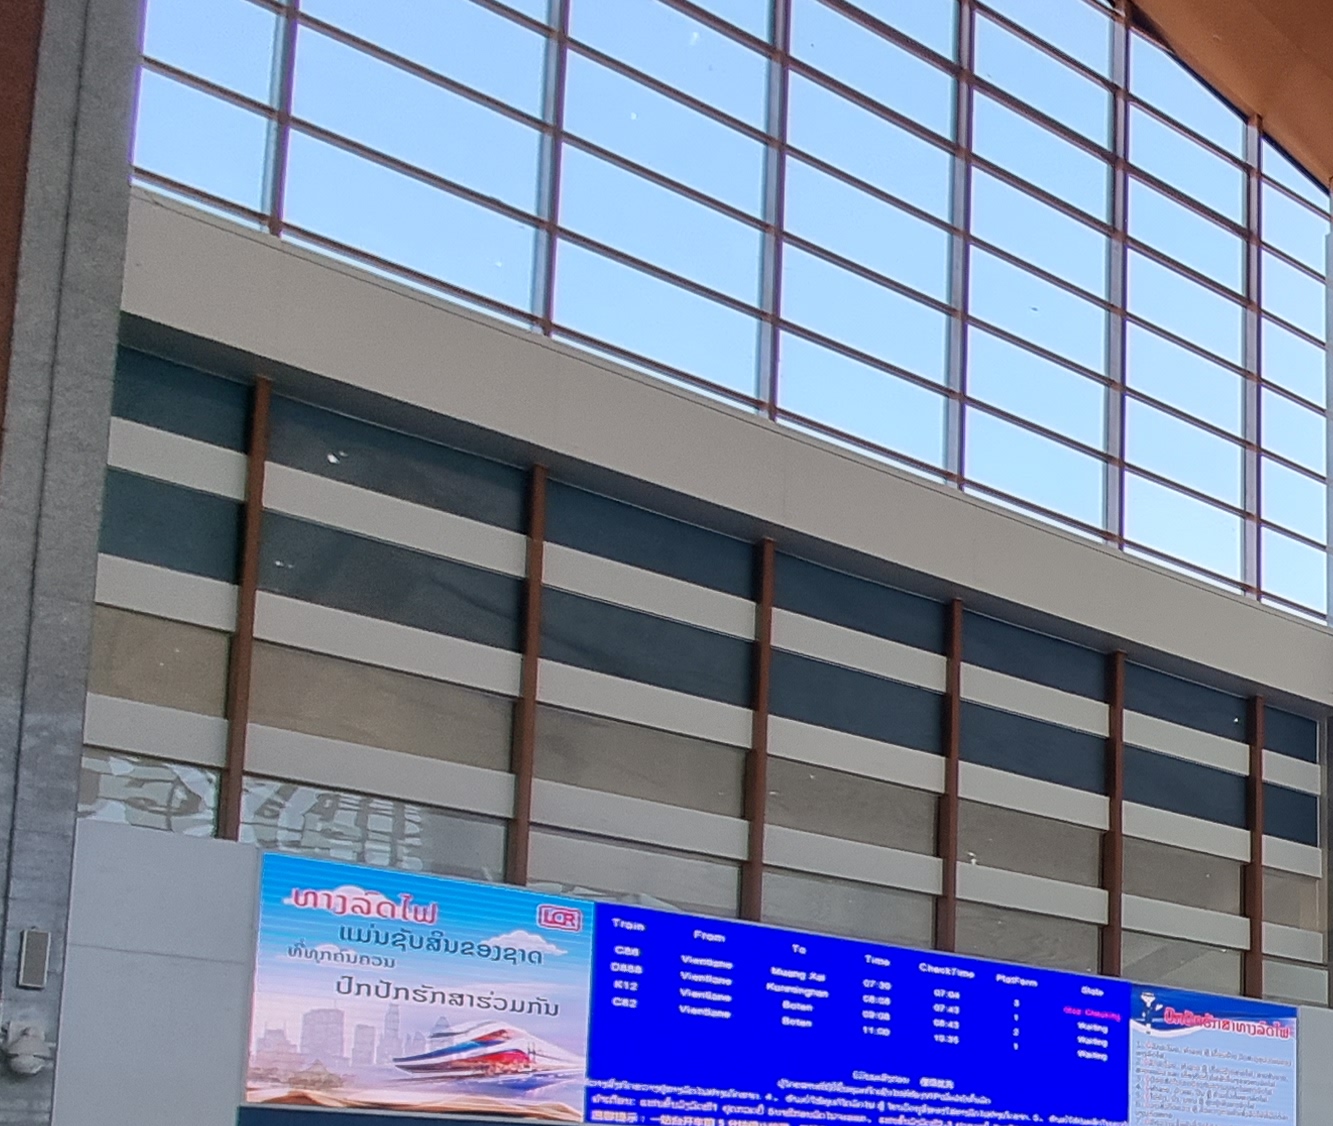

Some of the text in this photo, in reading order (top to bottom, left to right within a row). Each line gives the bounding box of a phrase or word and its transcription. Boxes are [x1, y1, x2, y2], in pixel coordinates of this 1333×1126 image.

[292, 886, 440, 925] ທາງລົດໄຟ
[611, 917, 646, 931] Train
[693, 929, 726, 943] From
[792, 943, 807, 955] To
[864, 954, 891, 967] Time
[996, 973, 1038, 988] Platform
[680, 954, 734, 970] Vientiane
[613, 980, 638, 992] K12
[679, 988, 733, 1003] Vientiane
[782, 999, 814, 1012] Boten
[1077, 1035, 1109, 1049] Waiting
[678, 1004, 732, 1019] Vientiane
[781, 1015, 813, 1028] Boten
[1077, 1049, 1108, 1063] Waiting
[680, 971, 733, 986] Vientiane
[1077, 1021, 1109, 1035] Waiting
